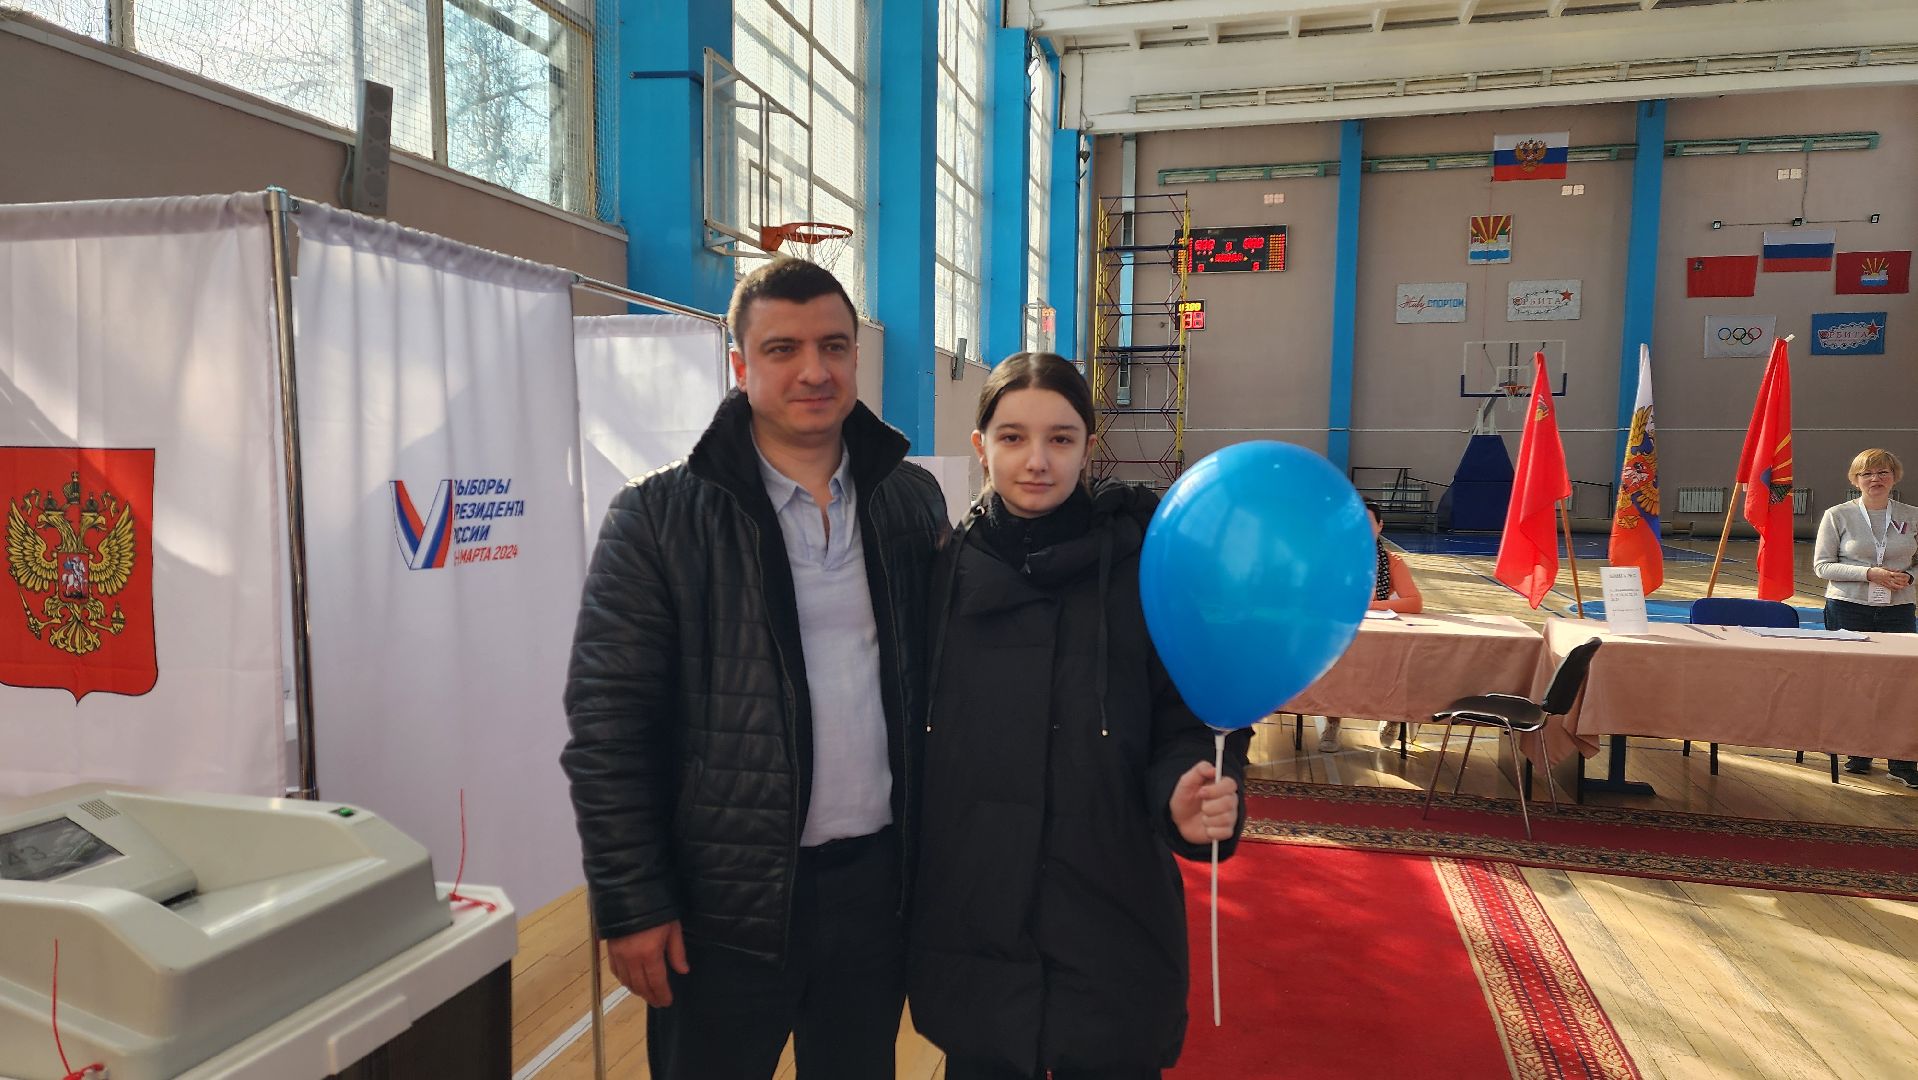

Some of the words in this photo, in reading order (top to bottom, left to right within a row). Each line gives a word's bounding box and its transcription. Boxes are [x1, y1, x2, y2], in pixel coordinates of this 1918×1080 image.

[453, 478, 511, 496] ЫБОРЫ
[453, 500, 524, 520] РЕЗИДЕНТА
[453, 525, 491, 544] ССИИ
[492, 544, 518, 560] 2024
